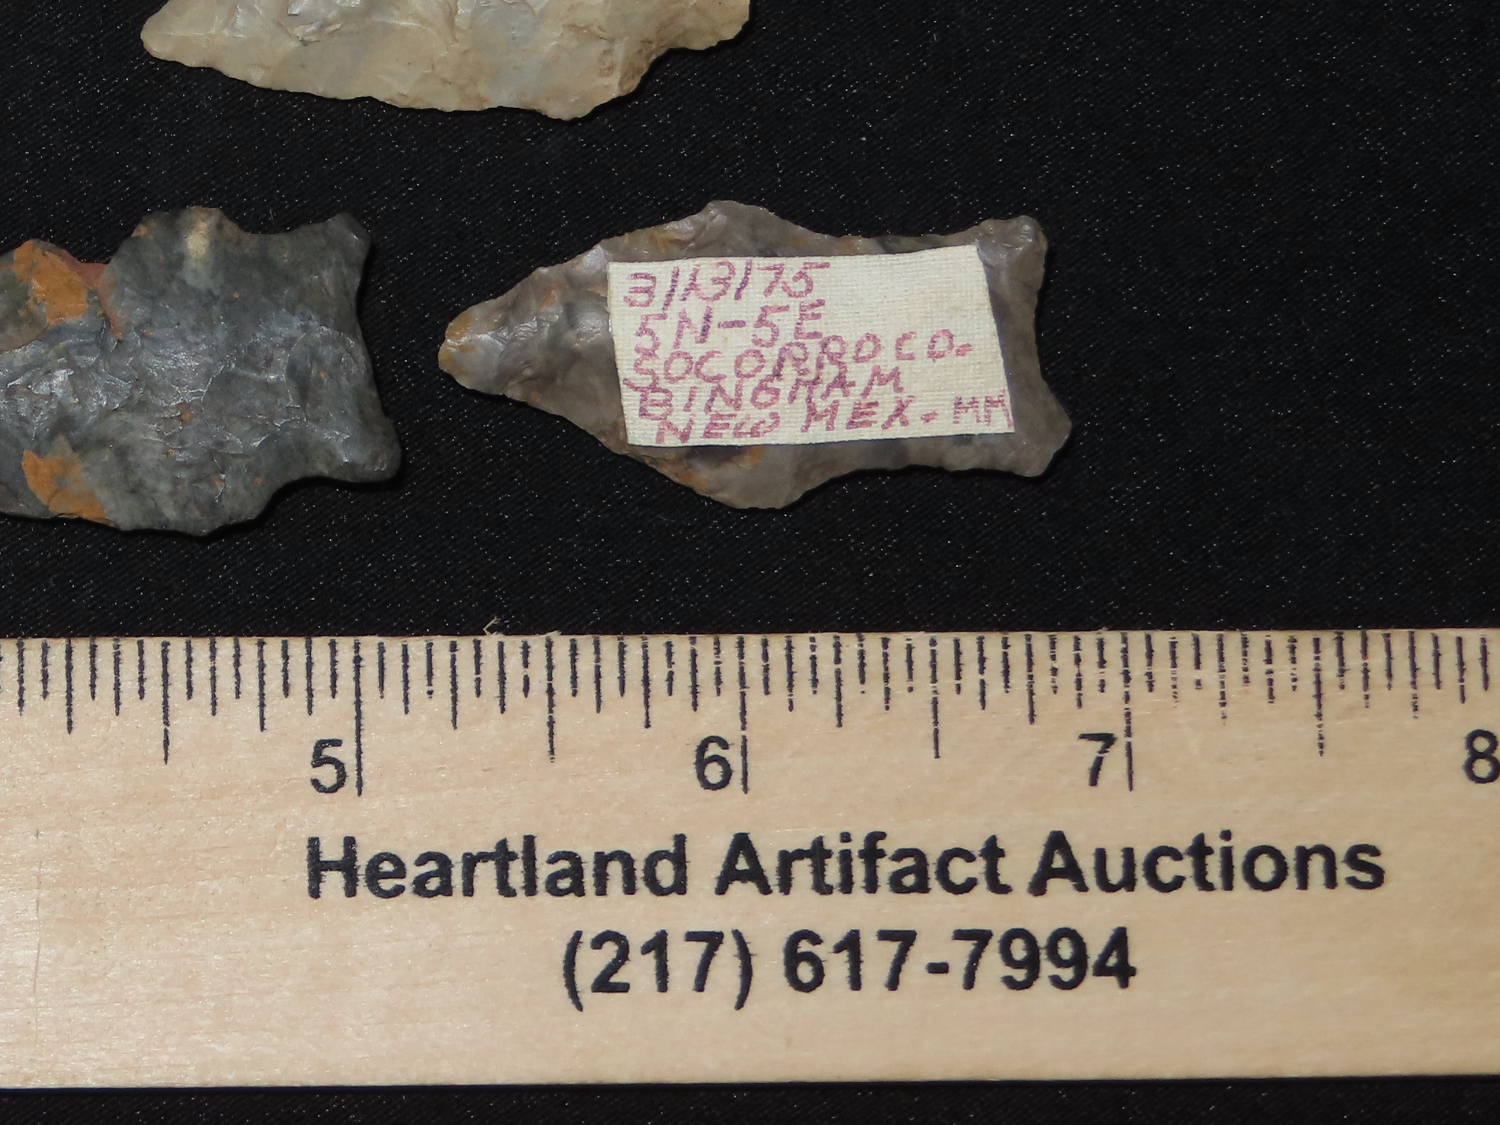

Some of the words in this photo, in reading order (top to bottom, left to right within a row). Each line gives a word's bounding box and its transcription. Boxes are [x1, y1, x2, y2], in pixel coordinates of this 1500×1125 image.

[655, 412, 781, 444] NEW
[310, 738, 347, 794] 5
[694, 735, 734, 790] 6
[1078, 733, 1117, 788] 7
[1463, 730, 1500, 785] 8
[306, 834, 688, 899] Heartland
[714, 831, 1012, 897] Artifact
[1027, 830, 1386, 896] Auctions
[562, 929, 754, 1011] (217)
[782, 927, 1137, 991] 617-7994
